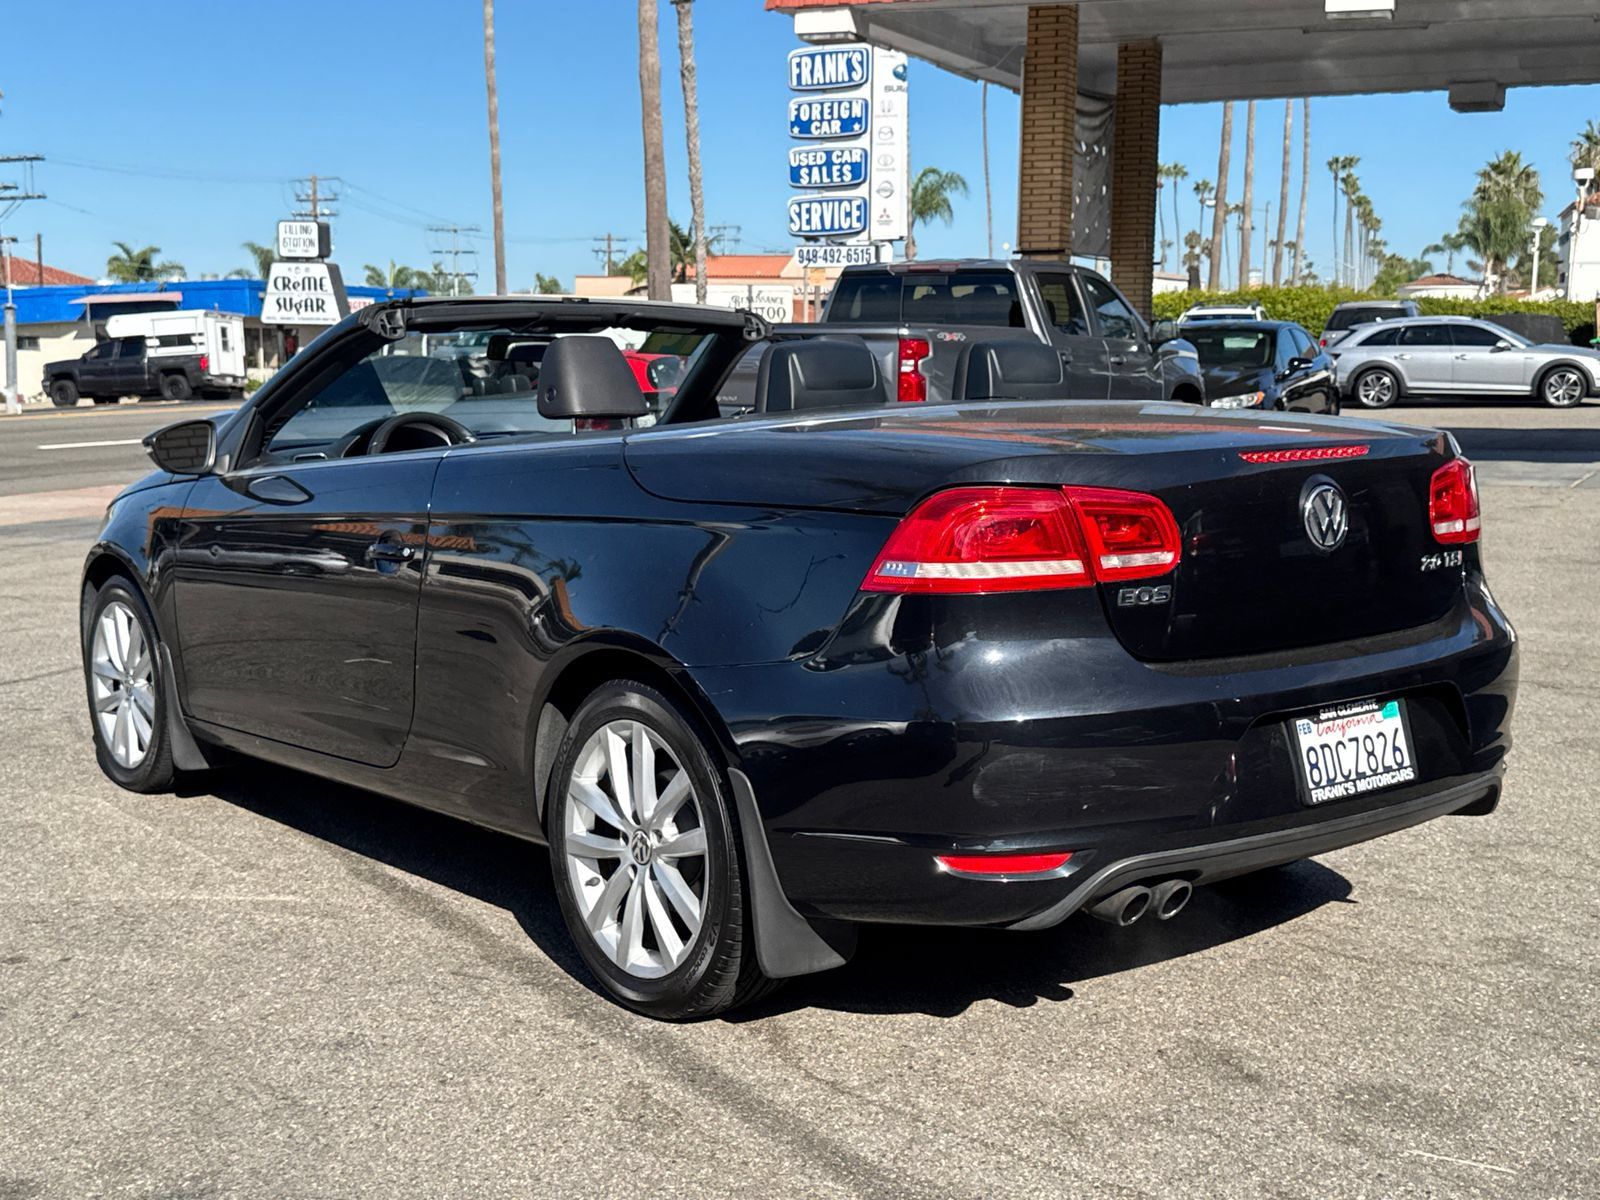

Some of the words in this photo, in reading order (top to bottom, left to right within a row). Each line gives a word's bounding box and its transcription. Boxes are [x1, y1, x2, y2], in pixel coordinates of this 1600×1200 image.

[791, 51, 863, 87] FRANK'S
[790, 100, 862, 122] FOREIGN
[810, 120, 841, 135] CAR
[790, 150, 826, 167] USED
[831, 148, 862, 164] CAR
[800, 164, 852, 185] SALES
[789, 200, 862, 231] SERVICE
[798, 247, 872, 264] 949-492-6515
[1117, 584, 1171, 606] EOS
[1316, 713, 1384, 738] California
[1306, 727, 1405, 788] 8DCZ826
[1311, 782, 1356, 803] FRANK'S
[1355, 767, 1415, 792] MOTORCARS
